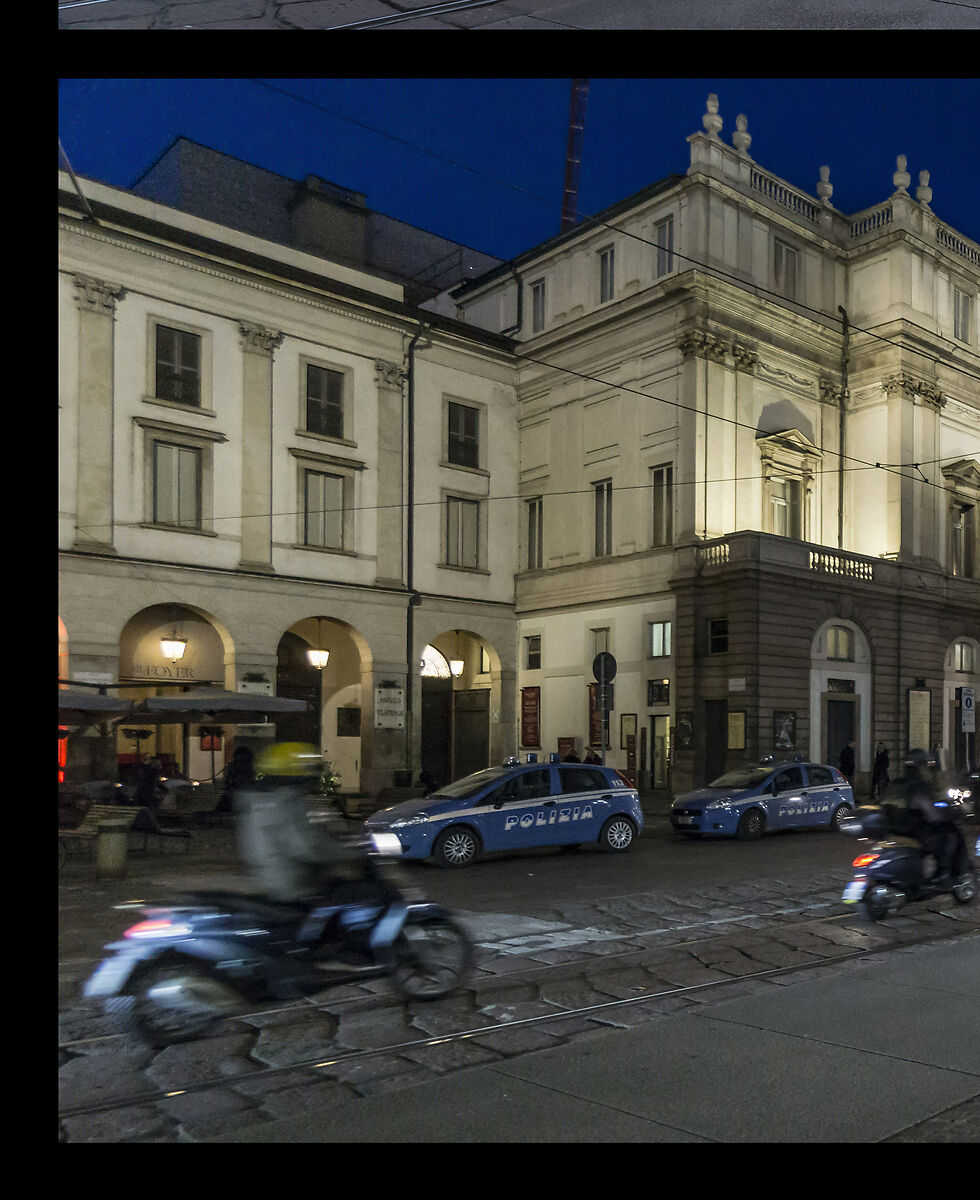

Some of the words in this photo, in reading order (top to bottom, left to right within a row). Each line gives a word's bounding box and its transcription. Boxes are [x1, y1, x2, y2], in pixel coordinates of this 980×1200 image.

[146, 664, 196, 678] FOYER
[778, 800, 830, 817] POLIZIA
[504, 805, 594, 831] POLIZIA
